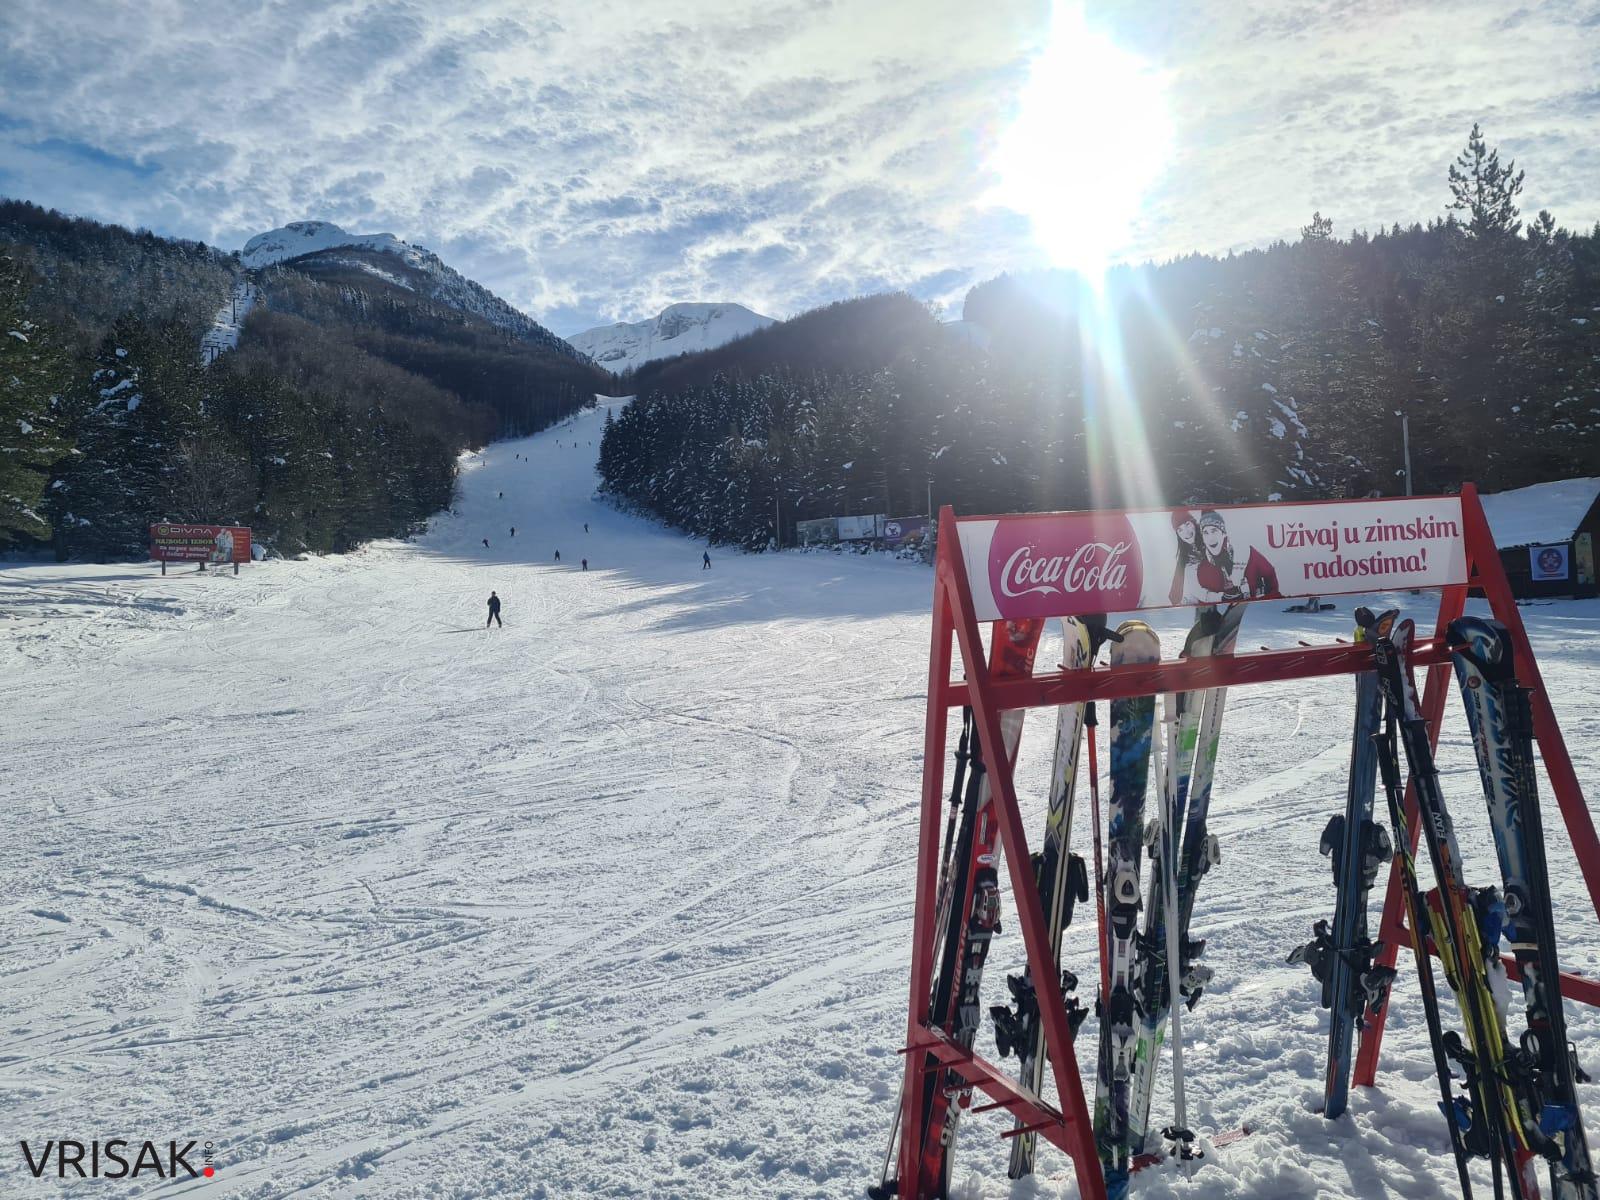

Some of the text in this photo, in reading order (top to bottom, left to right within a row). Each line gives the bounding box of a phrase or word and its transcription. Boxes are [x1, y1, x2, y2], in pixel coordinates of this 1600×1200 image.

[170, 527, 213, 536] DIVNA
[1266, 515, 1460, 552] Uživaj u zimskim
[1001, 542, 1132, 597] Coca-Cola
[1304, 548, 1428, 580] radostima!
